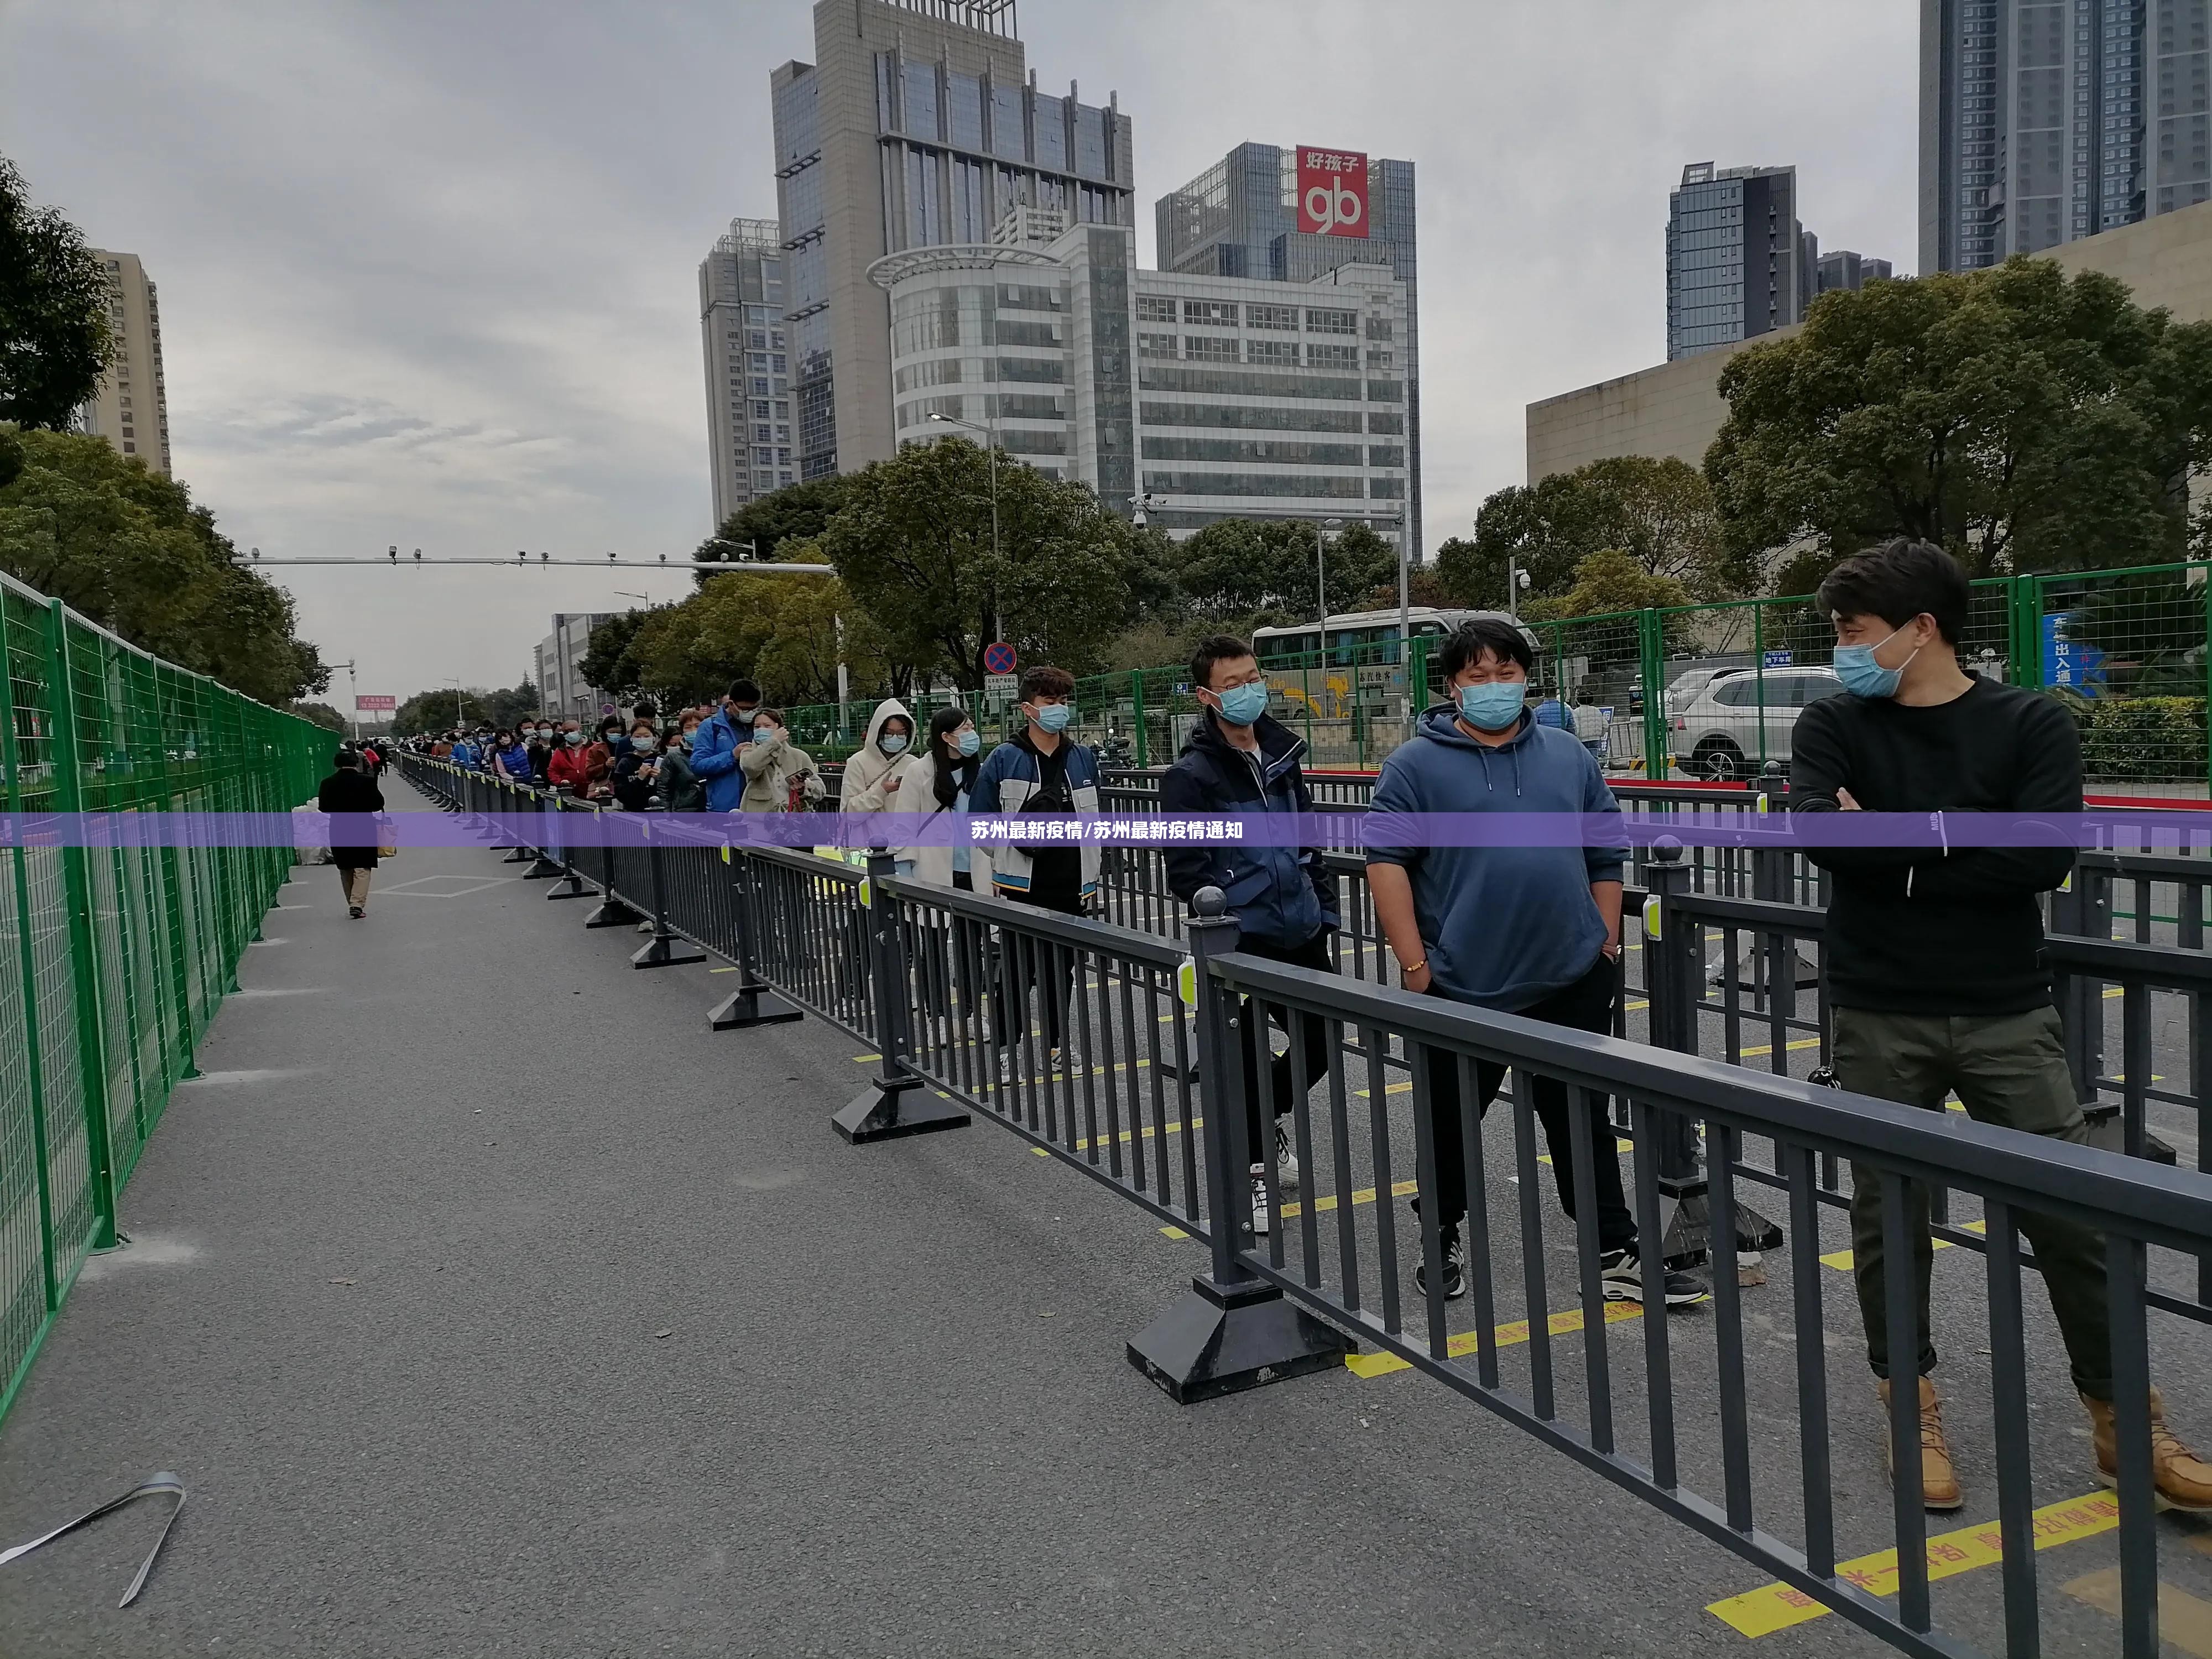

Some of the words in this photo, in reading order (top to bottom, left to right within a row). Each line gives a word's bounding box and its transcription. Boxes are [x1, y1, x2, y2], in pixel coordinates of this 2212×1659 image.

[1306, 152, 1359, 173] 好孩子
[1306, 175, 1361, 234] gb
